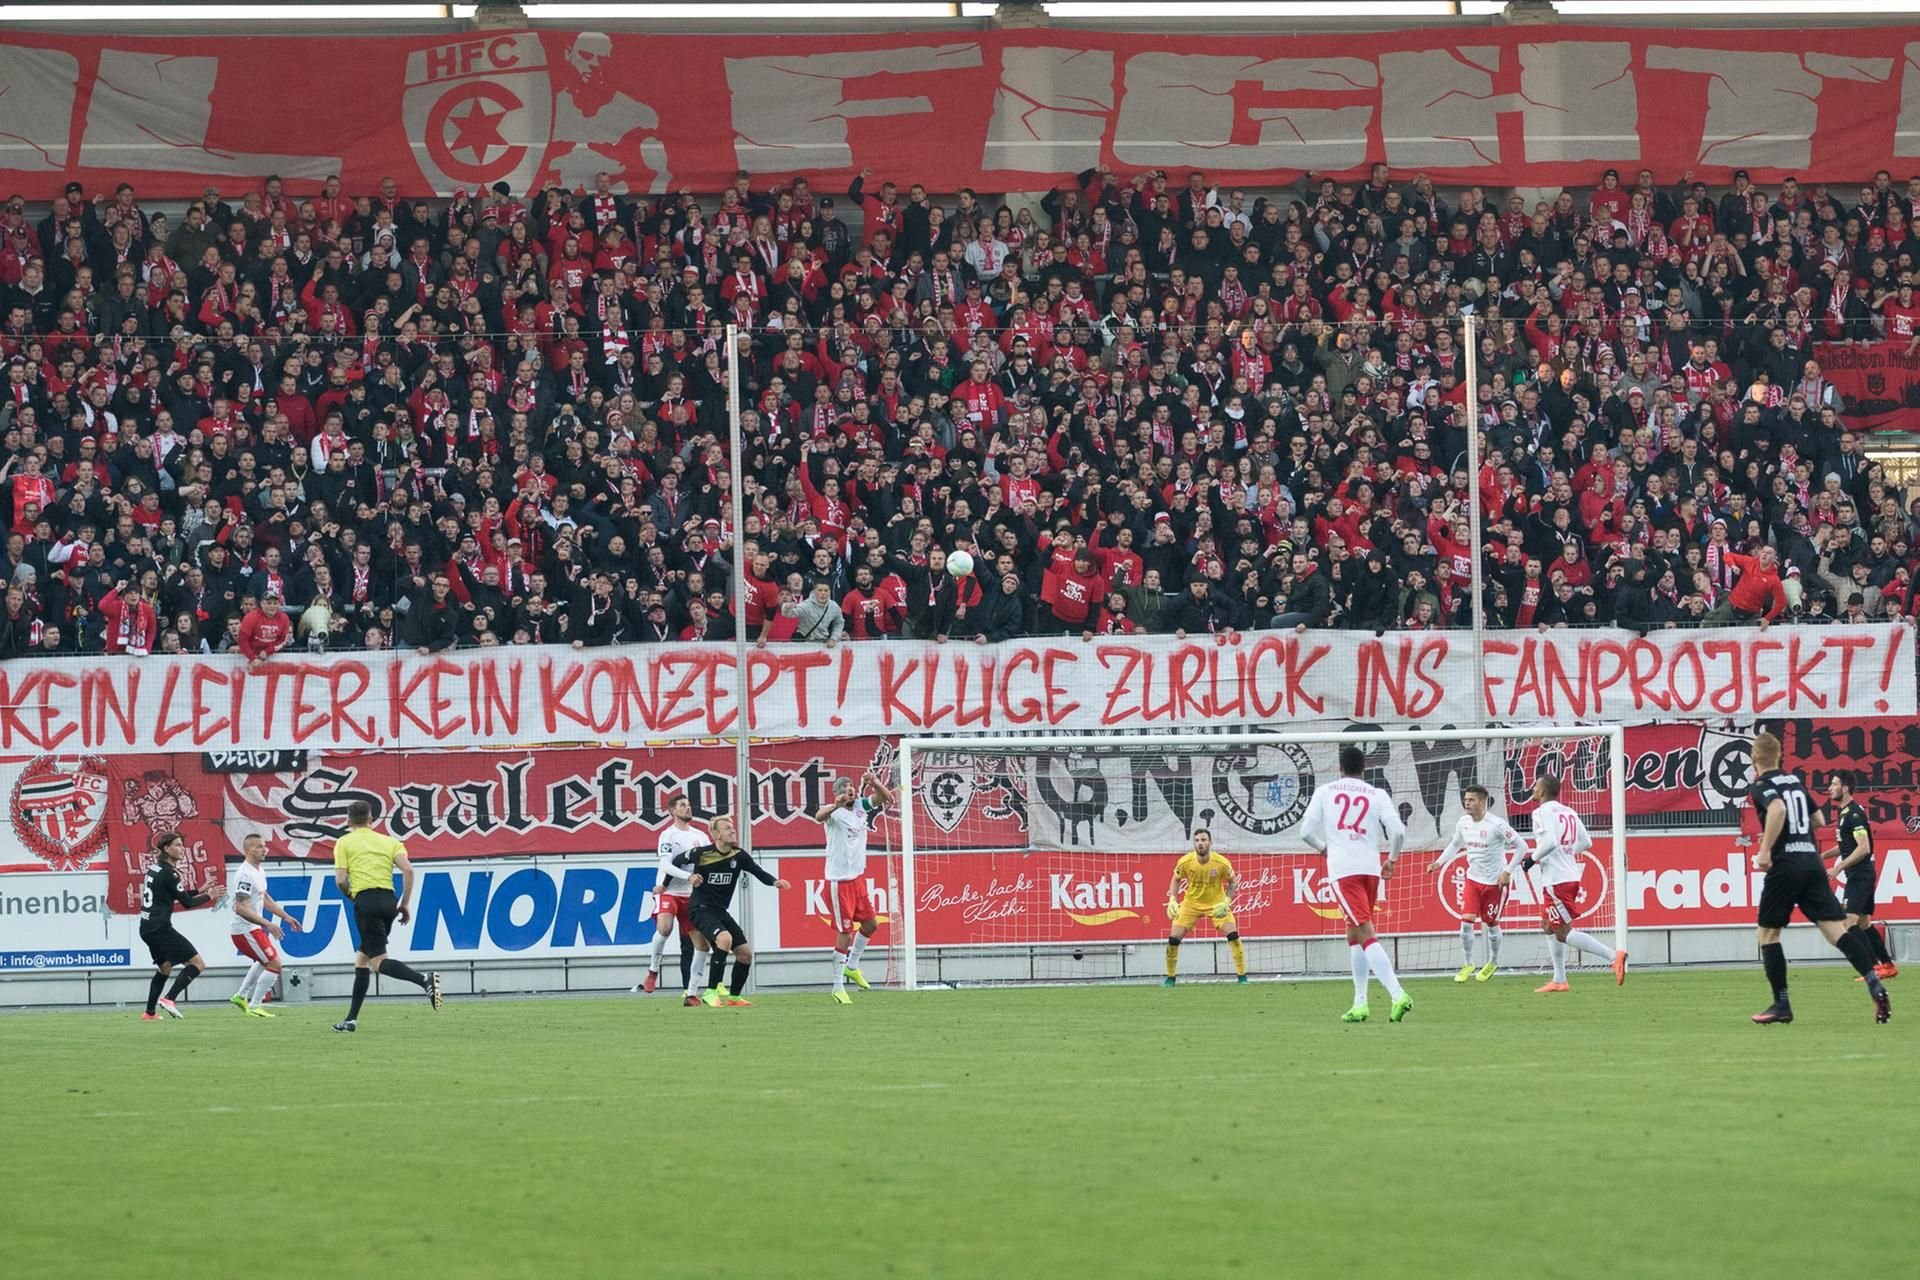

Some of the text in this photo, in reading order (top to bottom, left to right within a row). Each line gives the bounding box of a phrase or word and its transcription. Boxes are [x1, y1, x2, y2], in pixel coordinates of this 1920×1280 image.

[425, 37, 521, 80] HFC
[0, 628, 1905, 750] KEIN LEITER, KEIN KONZEPT! KLUGE ZURÜCK INS FANPROJEKT!
[931, 752, 968, 766] HFC
[281, 759, 830, 839] Saalefront
[1217, 792, 1309, 831] BLUE WHITE
[1334, 792, 1370, 834] 22
[1782, 789, 1810, 835] 10
[1559, 813, 1577, 846] 20
[708, 873, 733, 885] FAM
[804, 879, 898, 914] Khi
[987, 872, 1034, 898] backe
[1050, 871, 1145, 910] Kathi
[1627, 852, 1767, 910] radi
[963, 898, 1027, 924] Kathi
[1487, 903, 1499, 917] 34
[10, 953, 125, 968] info@wmb-halle.de
